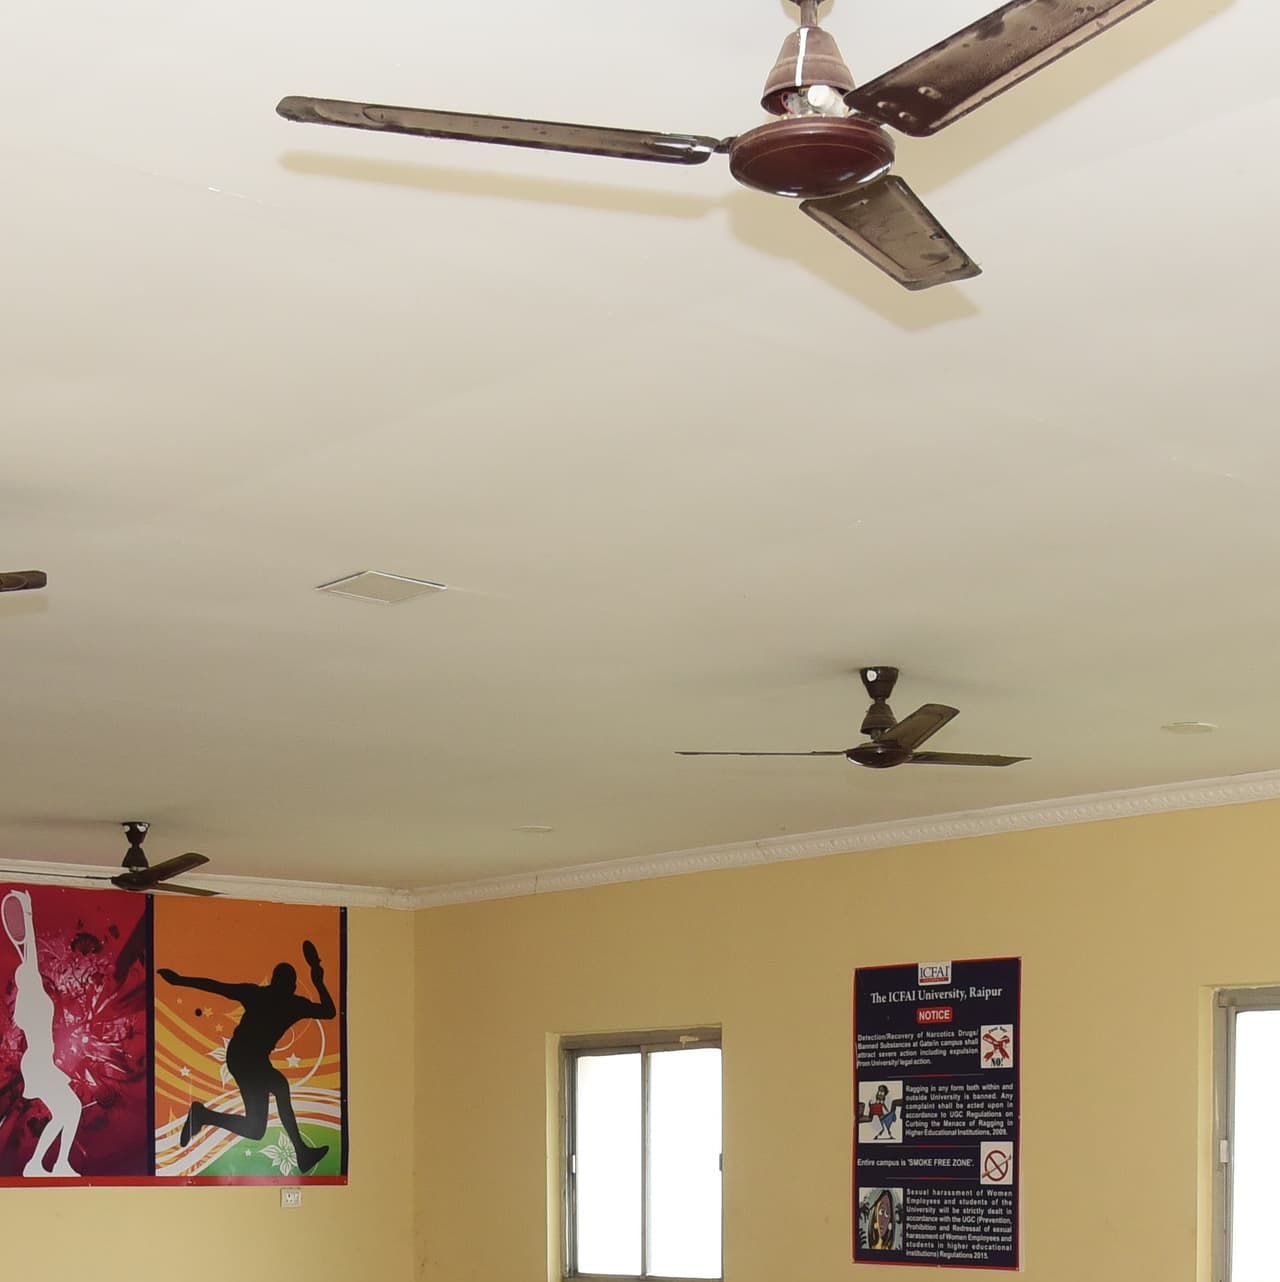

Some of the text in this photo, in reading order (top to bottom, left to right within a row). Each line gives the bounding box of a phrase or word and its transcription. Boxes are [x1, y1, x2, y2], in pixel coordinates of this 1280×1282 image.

[871, 986, 1003, 1004] The ICFAI University, Raipur
[919, 1009, 950, 1020] NOTICE
[906, 1085, 928, 1093] Ragging
[930, 1093, 960, 1101] University
[1001, 1092, 1013, 1100] Any
[950, 1110, 963, 1118] UGC
[978, 1119, 1004, 1128] Ragging
[857, 1158, 875, 1166] Entire
[876, 1159, 899, 1167] campus
[933, 1158, 952, 1167] FREE
[987, 1189, 1013, 1197] Women
